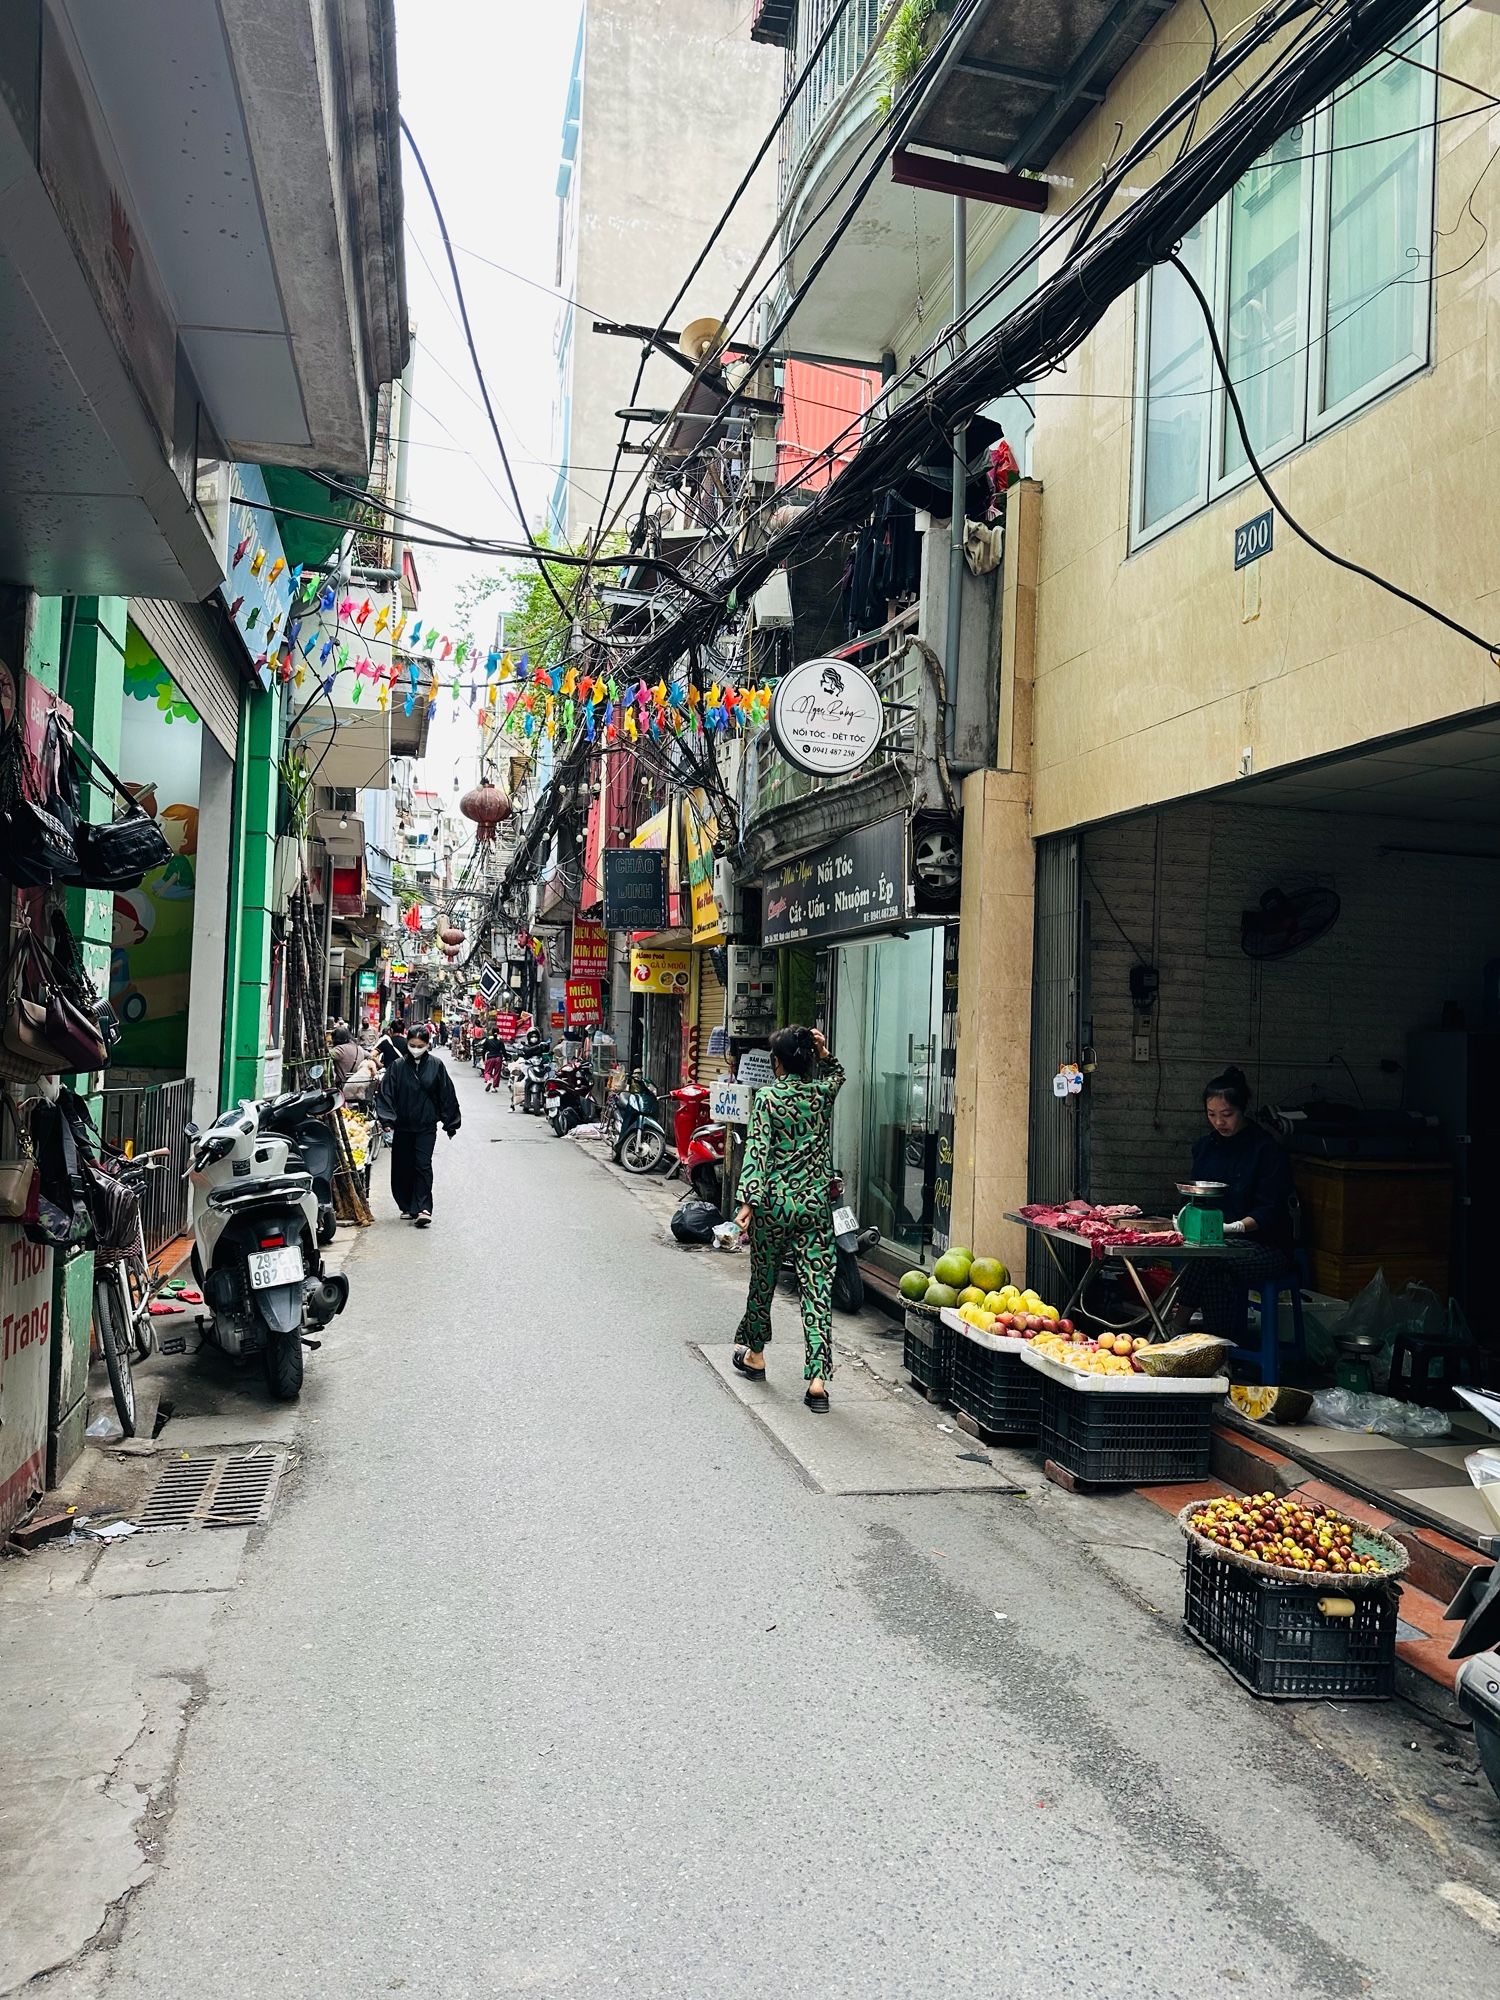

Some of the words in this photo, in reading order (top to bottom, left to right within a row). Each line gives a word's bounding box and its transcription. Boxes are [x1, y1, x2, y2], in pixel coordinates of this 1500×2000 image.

[1237, 519, 1268, 561] 200
[792, 727, 807, 737] NỐI
[809, 729, 826, 739] TÓC
[850, 734, 866, 743] TÓC
[812, 746, 828, 754] 0941
[830, 747, 841, 756] 487
[843, 749, 856, 758] 258
[817, 857, 833, 885] Nối
[835, 853, 853, 879] Tóc
[789, 900, 802, 924] Cắt
[808, 893, 826, 919] Uốn
[834, 885, 870, 913] Nhuộm
[878, 872, 894, 905] Ép
[569, 982, 592, 997] MIẾN
[726, 1104, 741, 1117] RÁC
[2, 1301, 49, 1361] Trang
